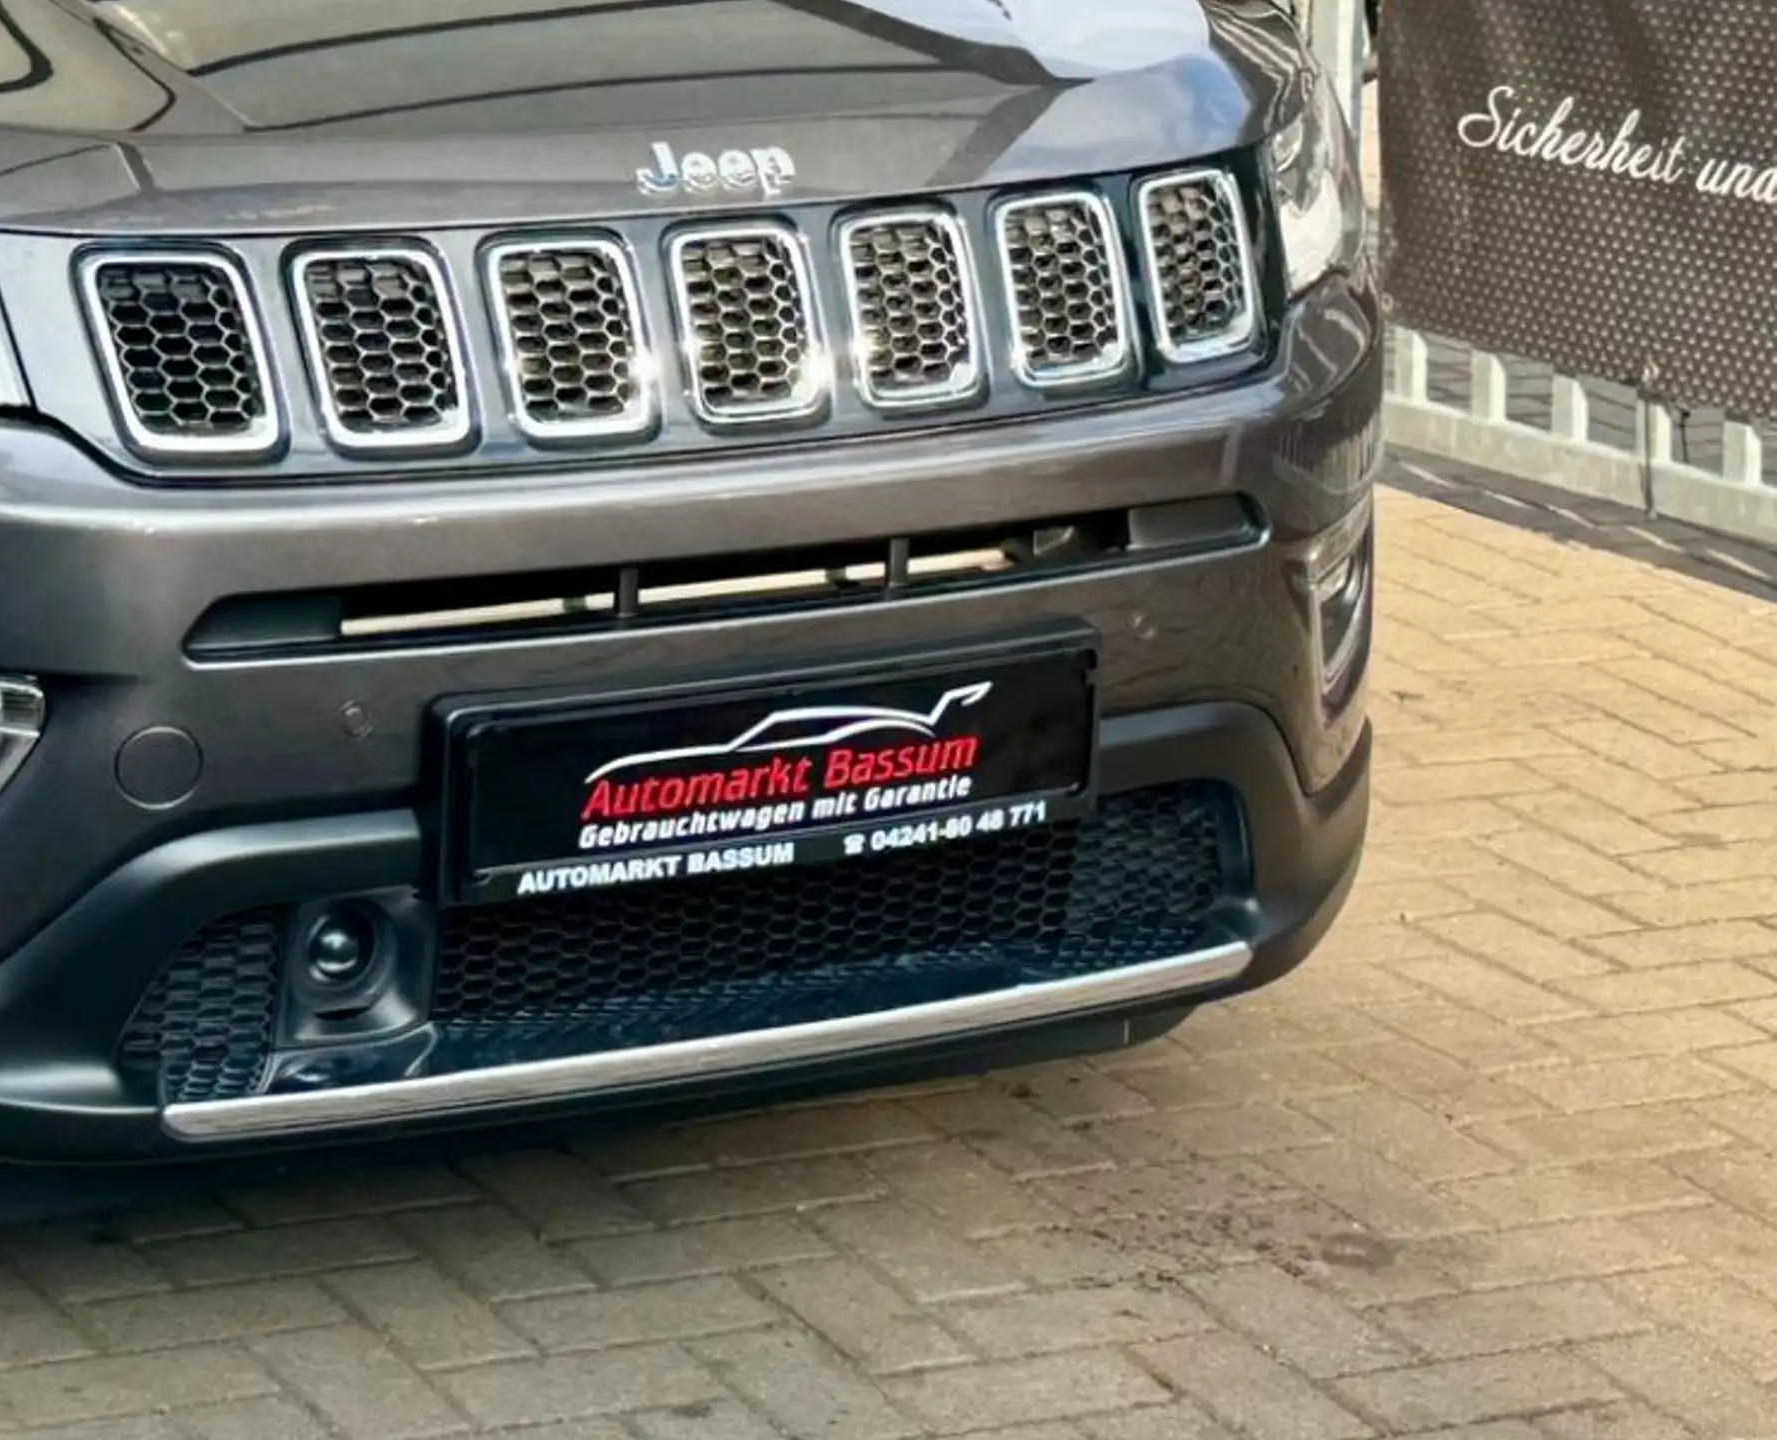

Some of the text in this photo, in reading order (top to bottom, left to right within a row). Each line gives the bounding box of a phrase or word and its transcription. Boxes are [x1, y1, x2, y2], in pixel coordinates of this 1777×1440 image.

[636, 141, 796, 197] Jeep
[1458, 85, 1685, 184] Sicherheit
[578, 774, 972, 849] Gebrauchtwagen mit Garantie
[581, 735, 978, 821] Automarkt Bassum
[517, 842, 796, 895] AUTOMARKT BASSUM
